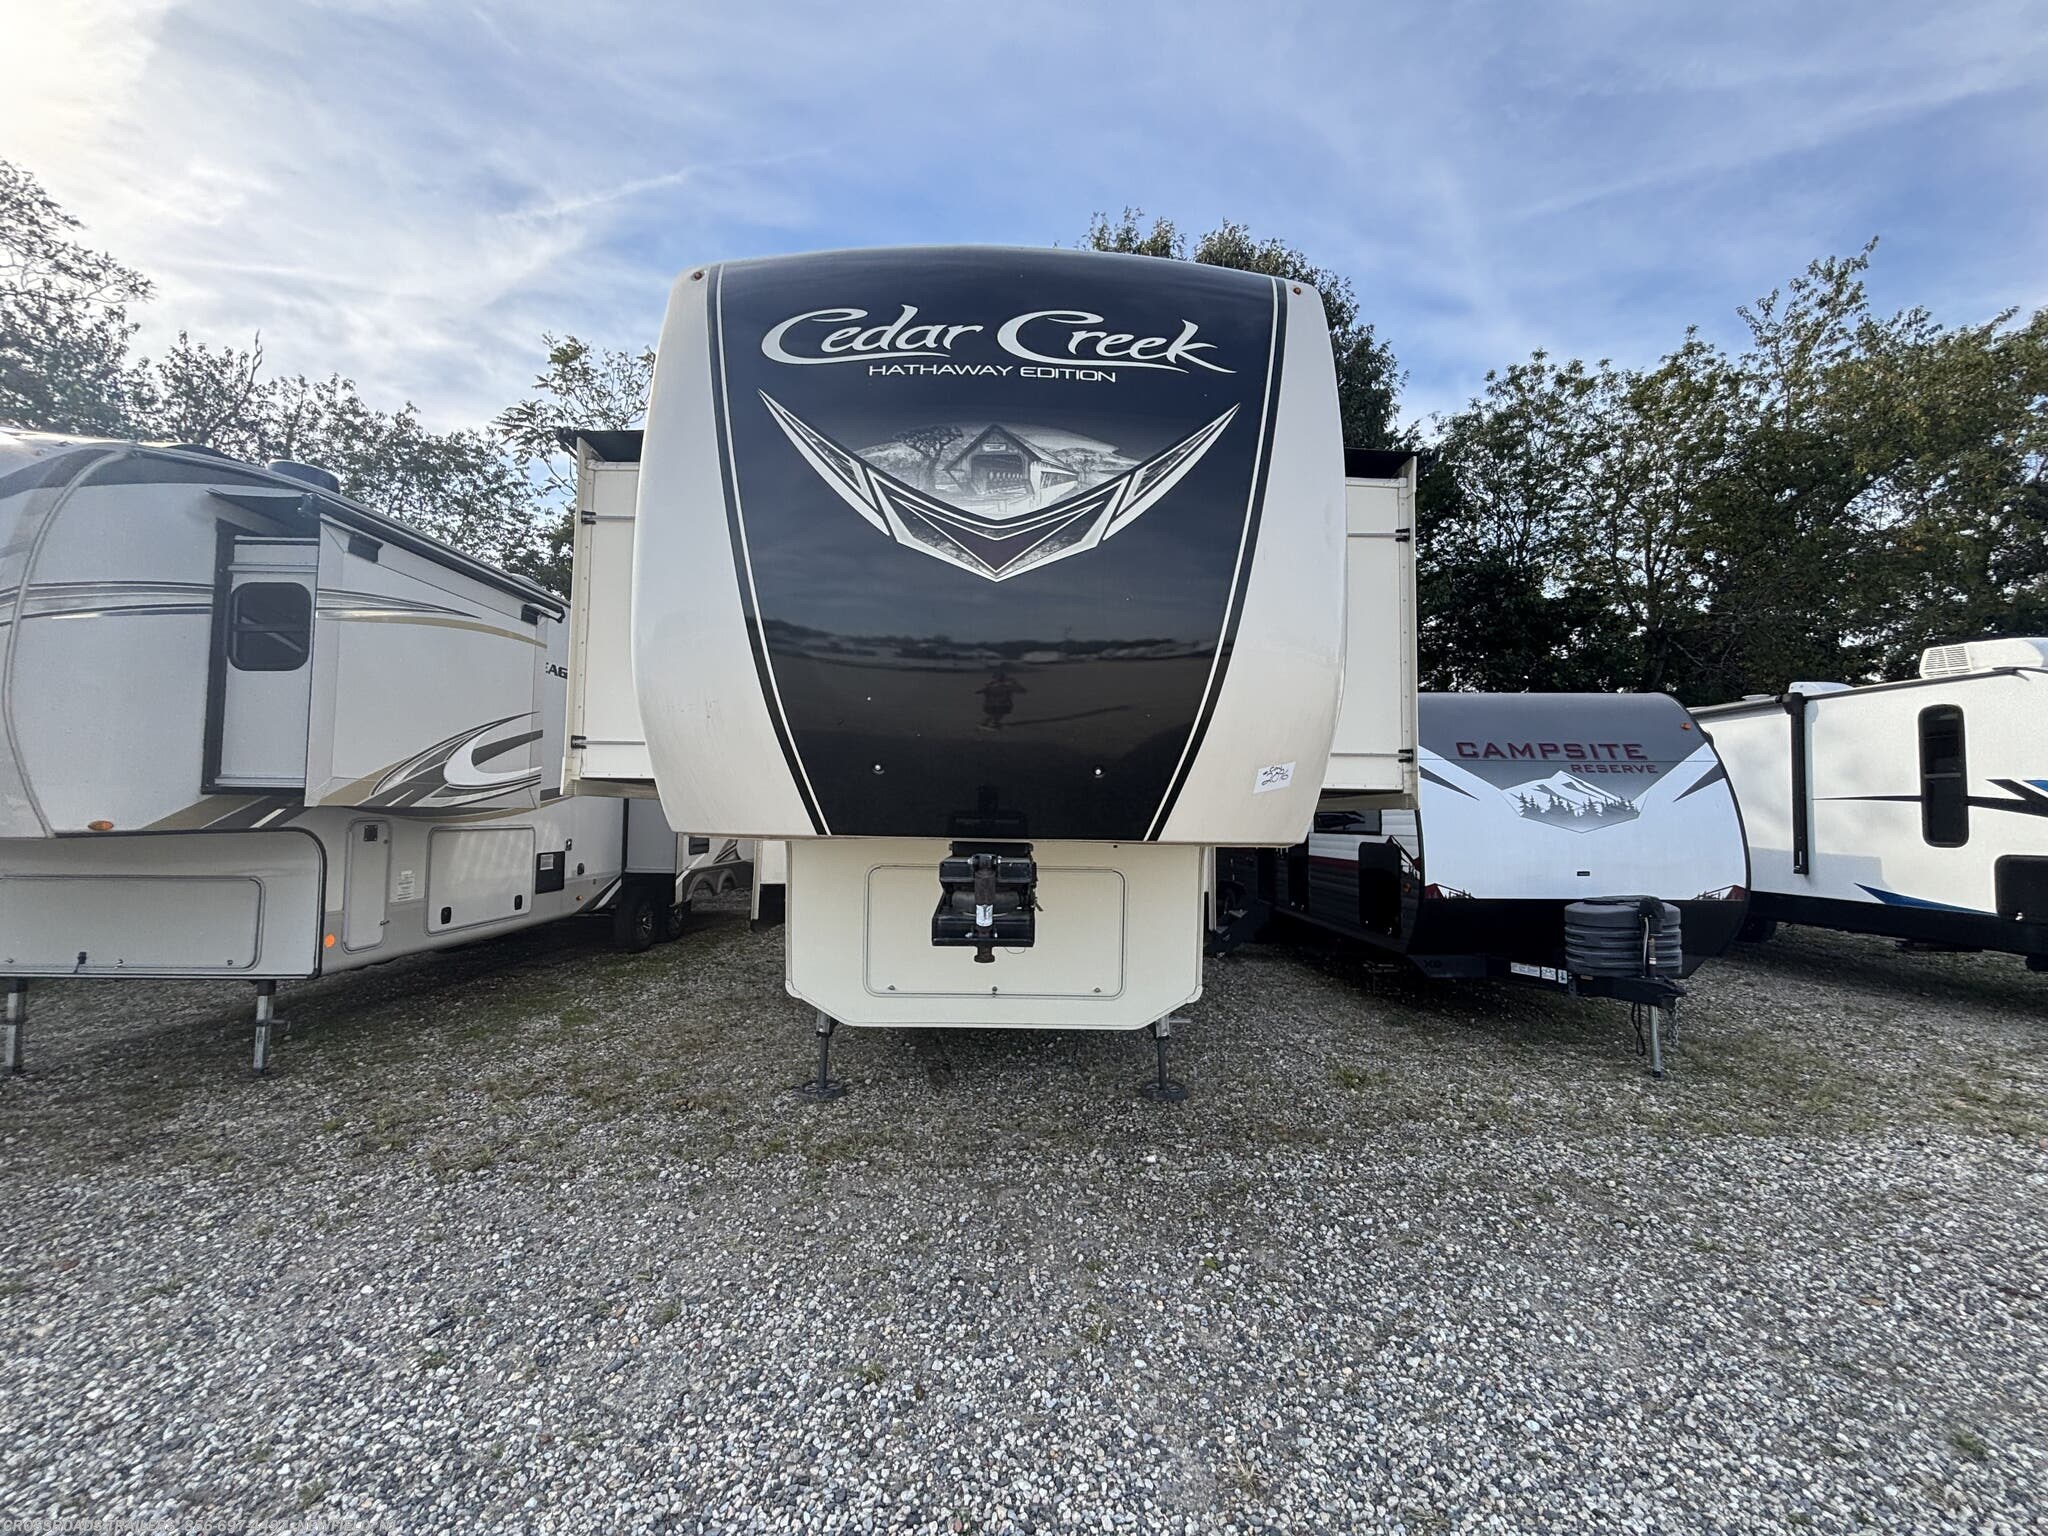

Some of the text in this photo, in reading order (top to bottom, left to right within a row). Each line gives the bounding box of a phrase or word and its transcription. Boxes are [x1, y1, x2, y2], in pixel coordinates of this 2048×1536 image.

[761, 305, 1237, 374] Cedar Creek
[868, 364, 1117, 382] HATHAWAY EDITION
[1455, 742, 1648, 760] CAMPSITE
[1570, 764, 1658, 774] RESERVE
